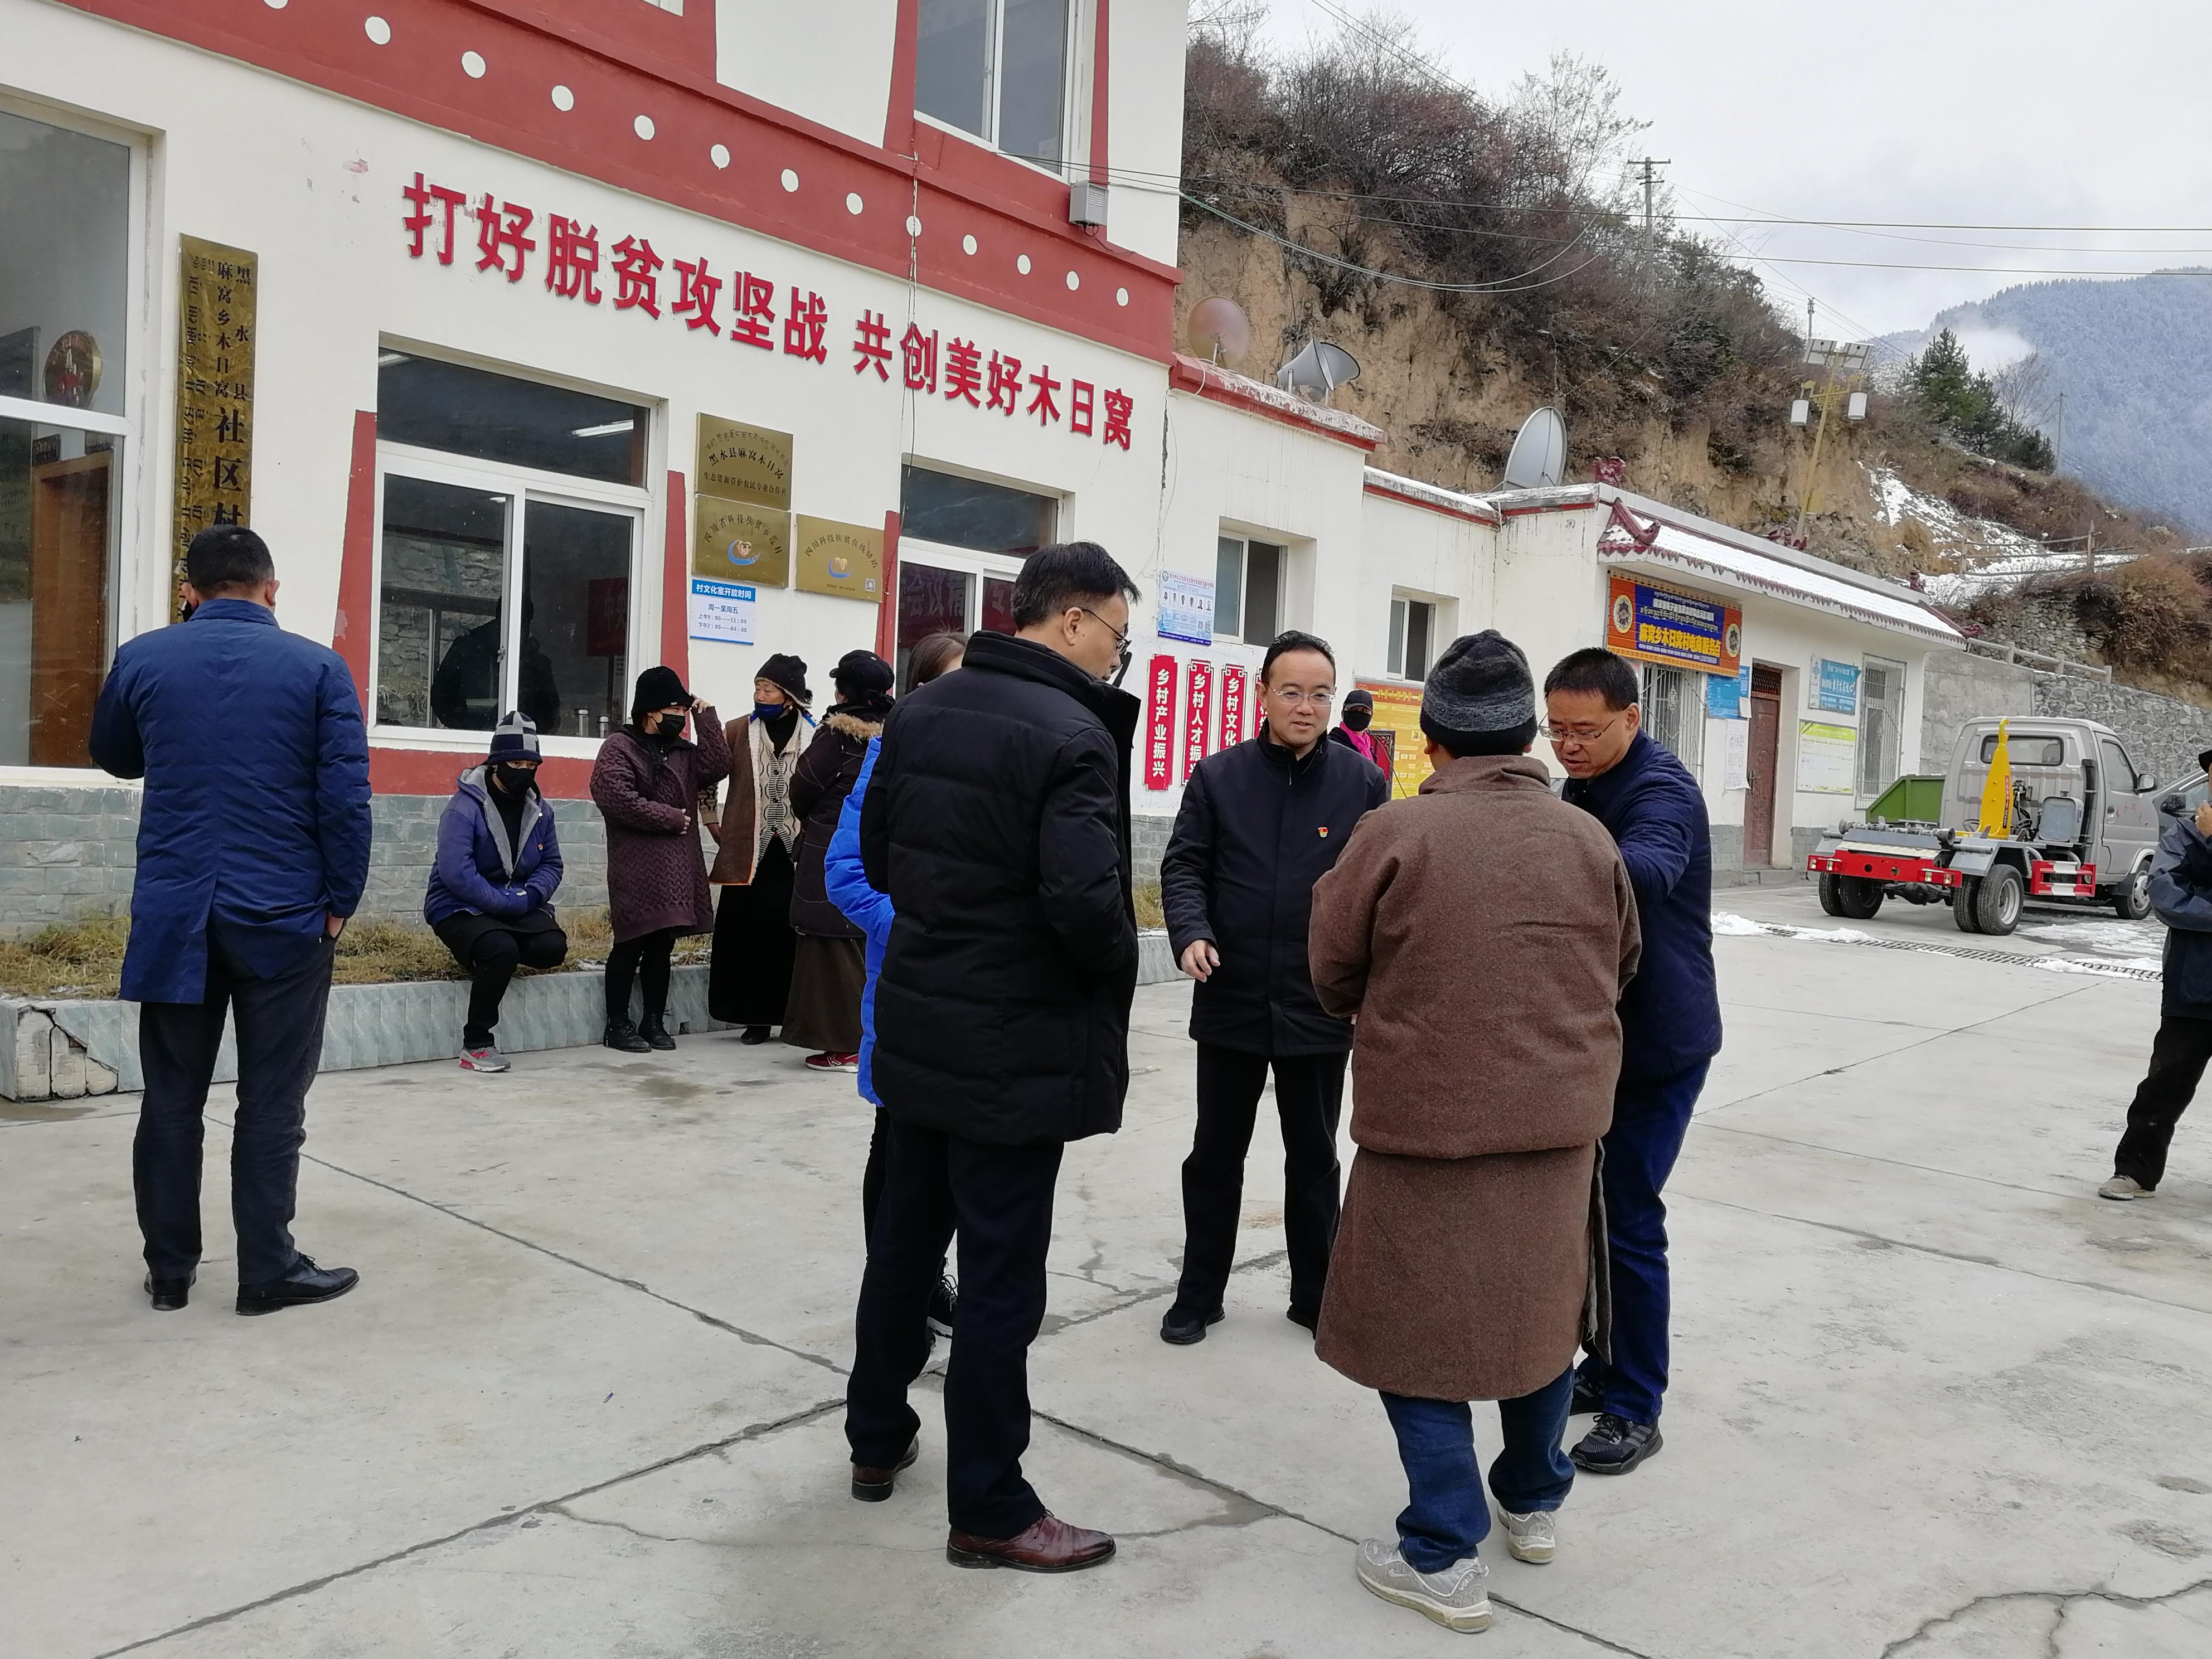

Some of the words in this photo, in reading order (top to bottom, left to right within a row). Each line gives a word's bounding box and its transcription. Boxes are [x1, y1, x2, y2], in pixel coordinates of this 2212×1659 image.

[234, 265, 251, 401] 黑水县
[402, 171, 828, 366] 打好脱贫攻坚战
[852, 309, 1134, 451] 共创美好木日窝
[703, 513, 783, 555] 四川省科技扶贫示范村
[696, 583, 751, 599] 村文化室开放时间
[708, 603, 739, 614] 周一至周五
[1152, 668, 1170, 778] 乡村产业振兴
[1225, 677, 1240, 749] 乡村文化
